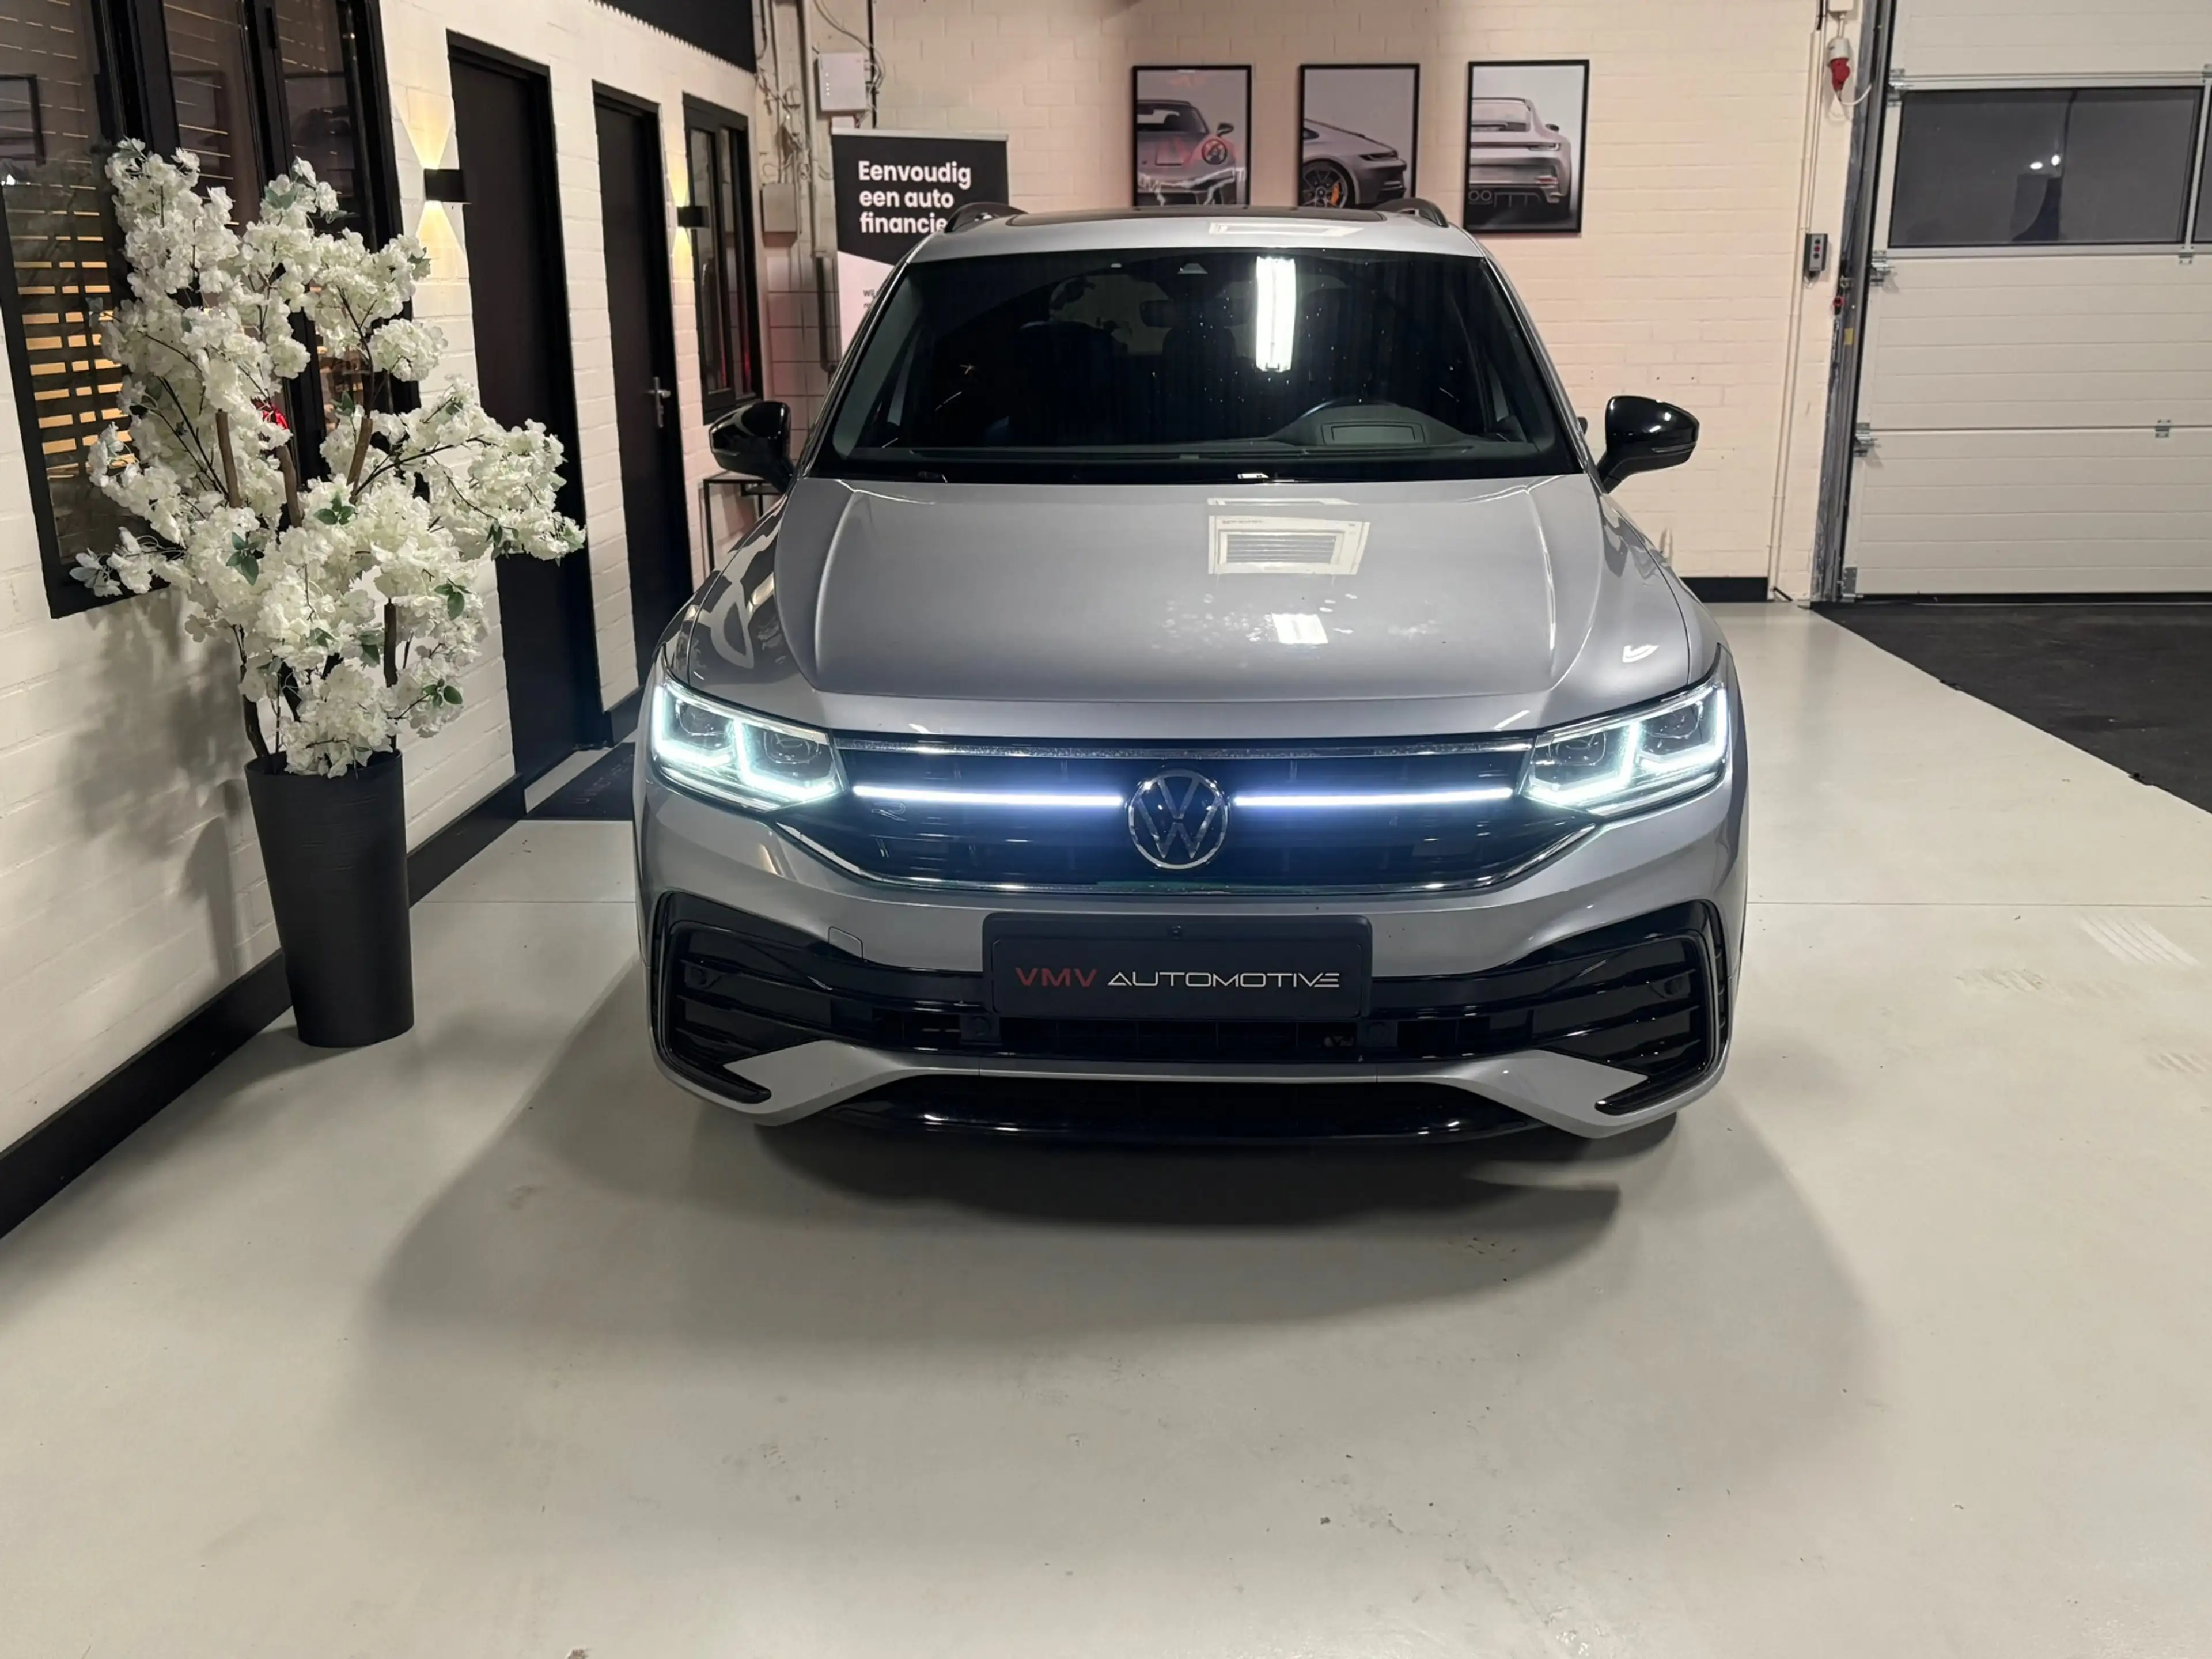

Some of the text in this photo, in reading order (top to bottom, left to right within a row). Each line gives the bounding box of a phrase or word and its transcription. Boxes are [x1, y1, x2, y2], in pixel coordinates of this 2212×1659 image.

[858, 160, 971, 190] Eenvoudig
[859, 188, 955, 208] een auto
[1016, 967, 1339, 988] VMV AUTOMOTIVE
